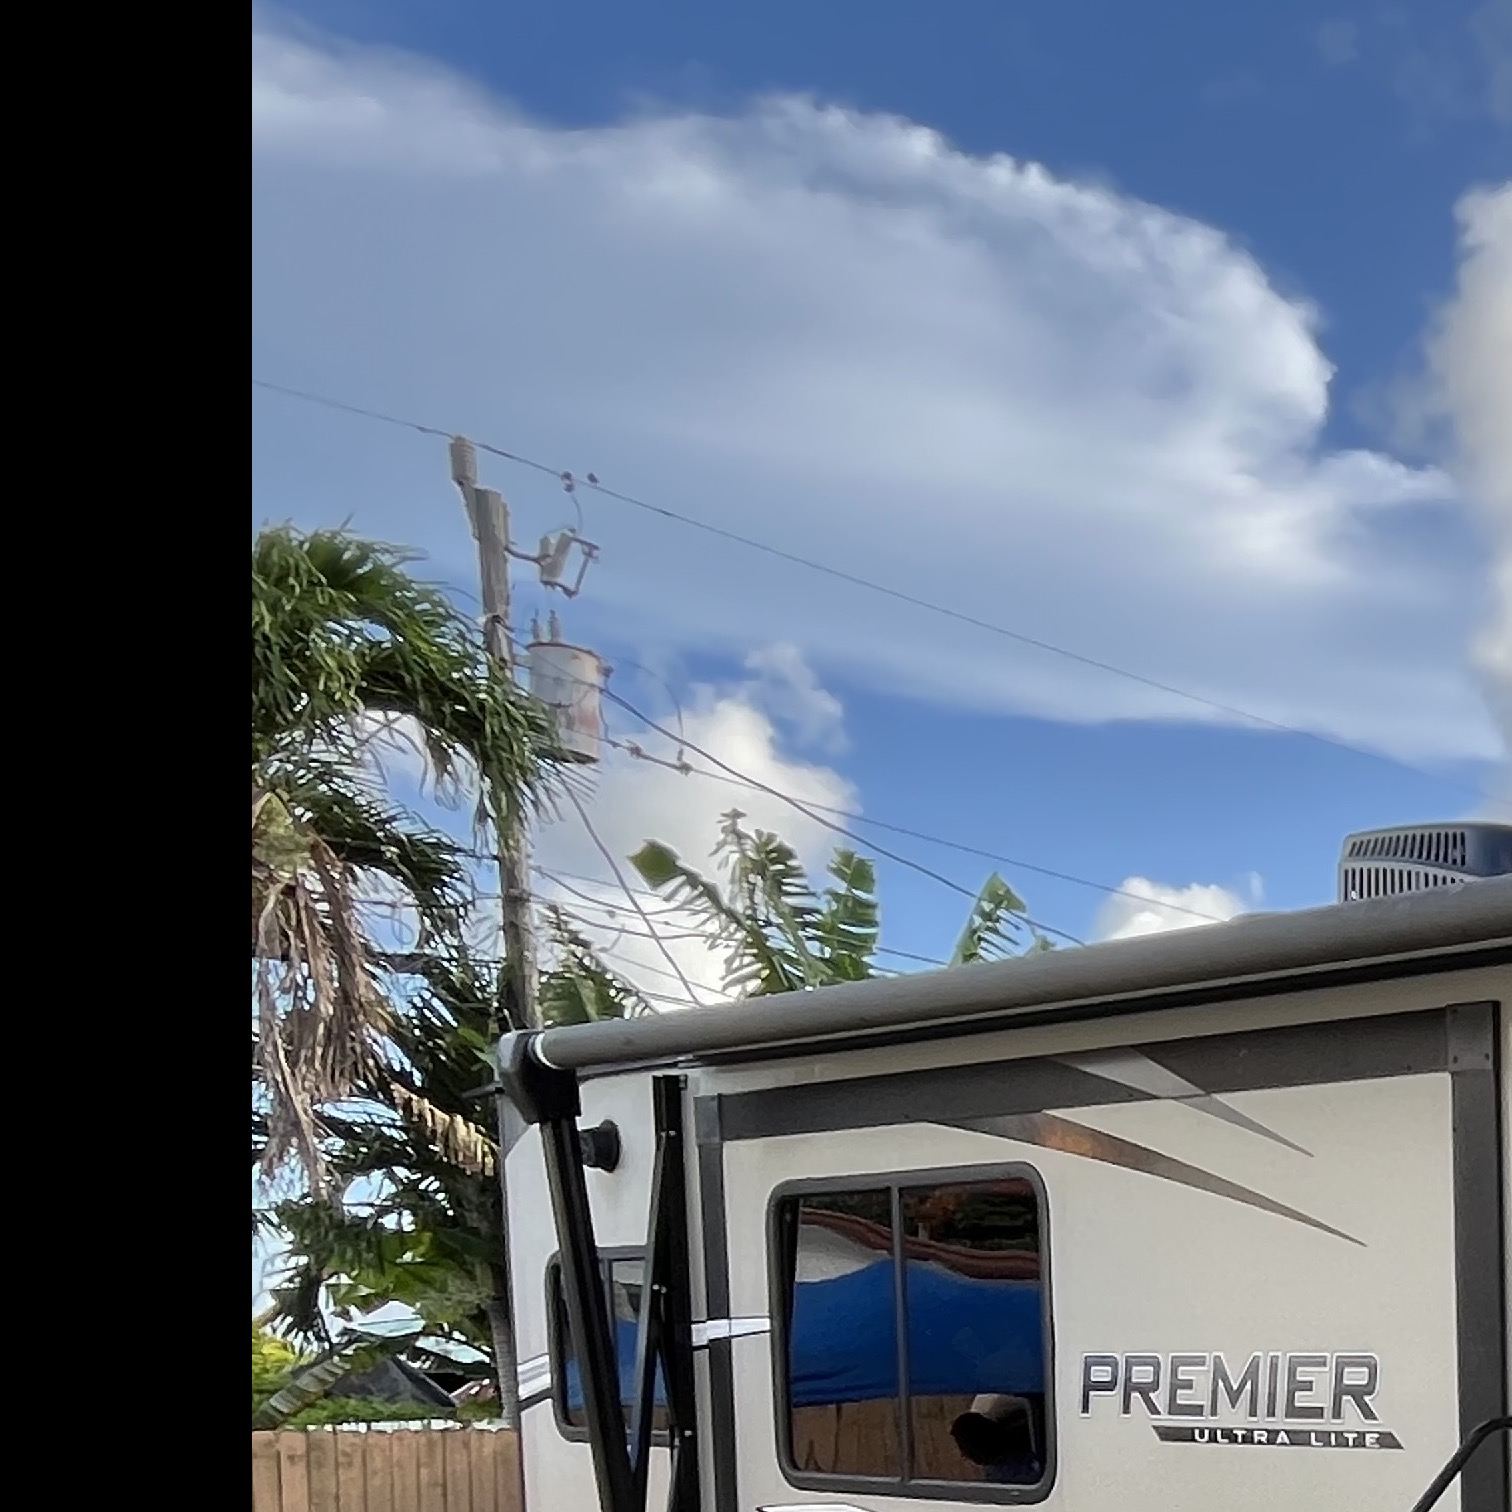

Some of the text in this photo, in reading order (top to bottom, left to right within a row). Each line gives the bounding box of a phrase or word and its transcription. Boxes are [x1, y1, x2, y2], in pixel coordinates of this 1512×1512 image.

[1080, 1351, 1383, 1423] PREMIER
[1193, 1427, 1382, 1448] ULTRA LITE
